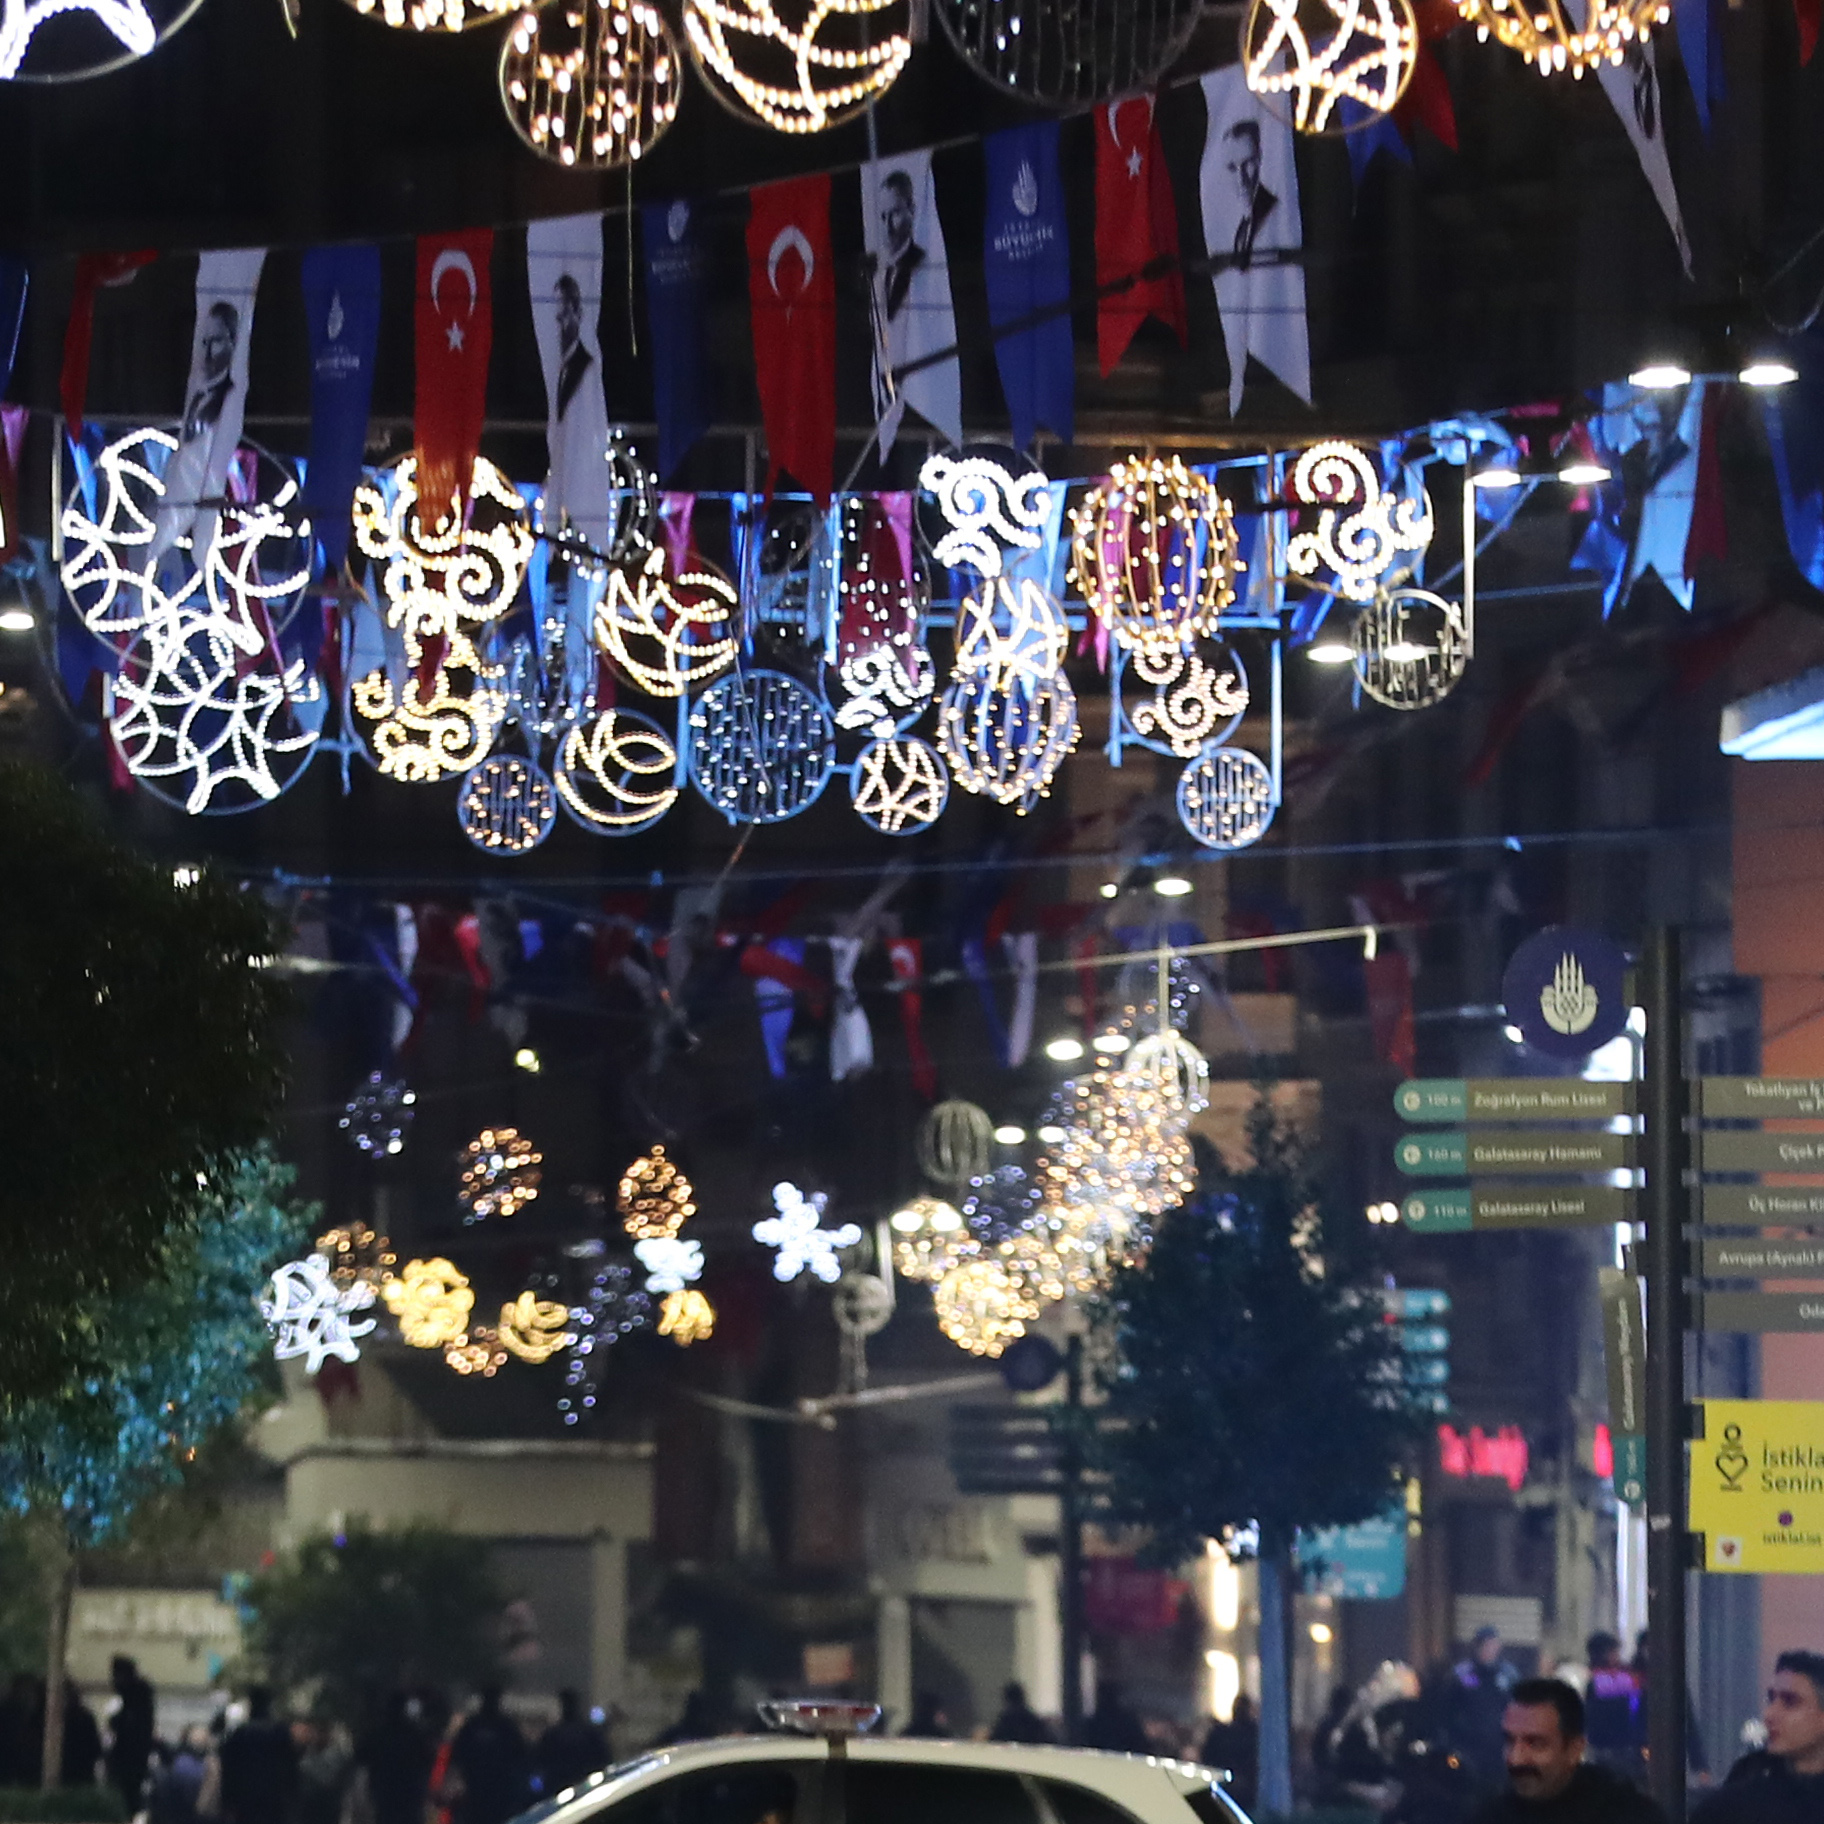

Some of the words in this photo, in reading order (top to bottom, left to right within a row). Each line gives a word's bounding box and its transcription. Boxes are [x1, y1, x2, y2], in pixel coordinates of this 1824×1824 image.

[1474, 1147, 1547, 1164] Galatasaray
[1479, 1200, 1549, 1217] Galatasaray
[1551, 1199, 1585, 1214] Lisesi
[1719, 1252, 1764, 1268] Avrupa
[1761, 1470, 1824, 1493] Senin
